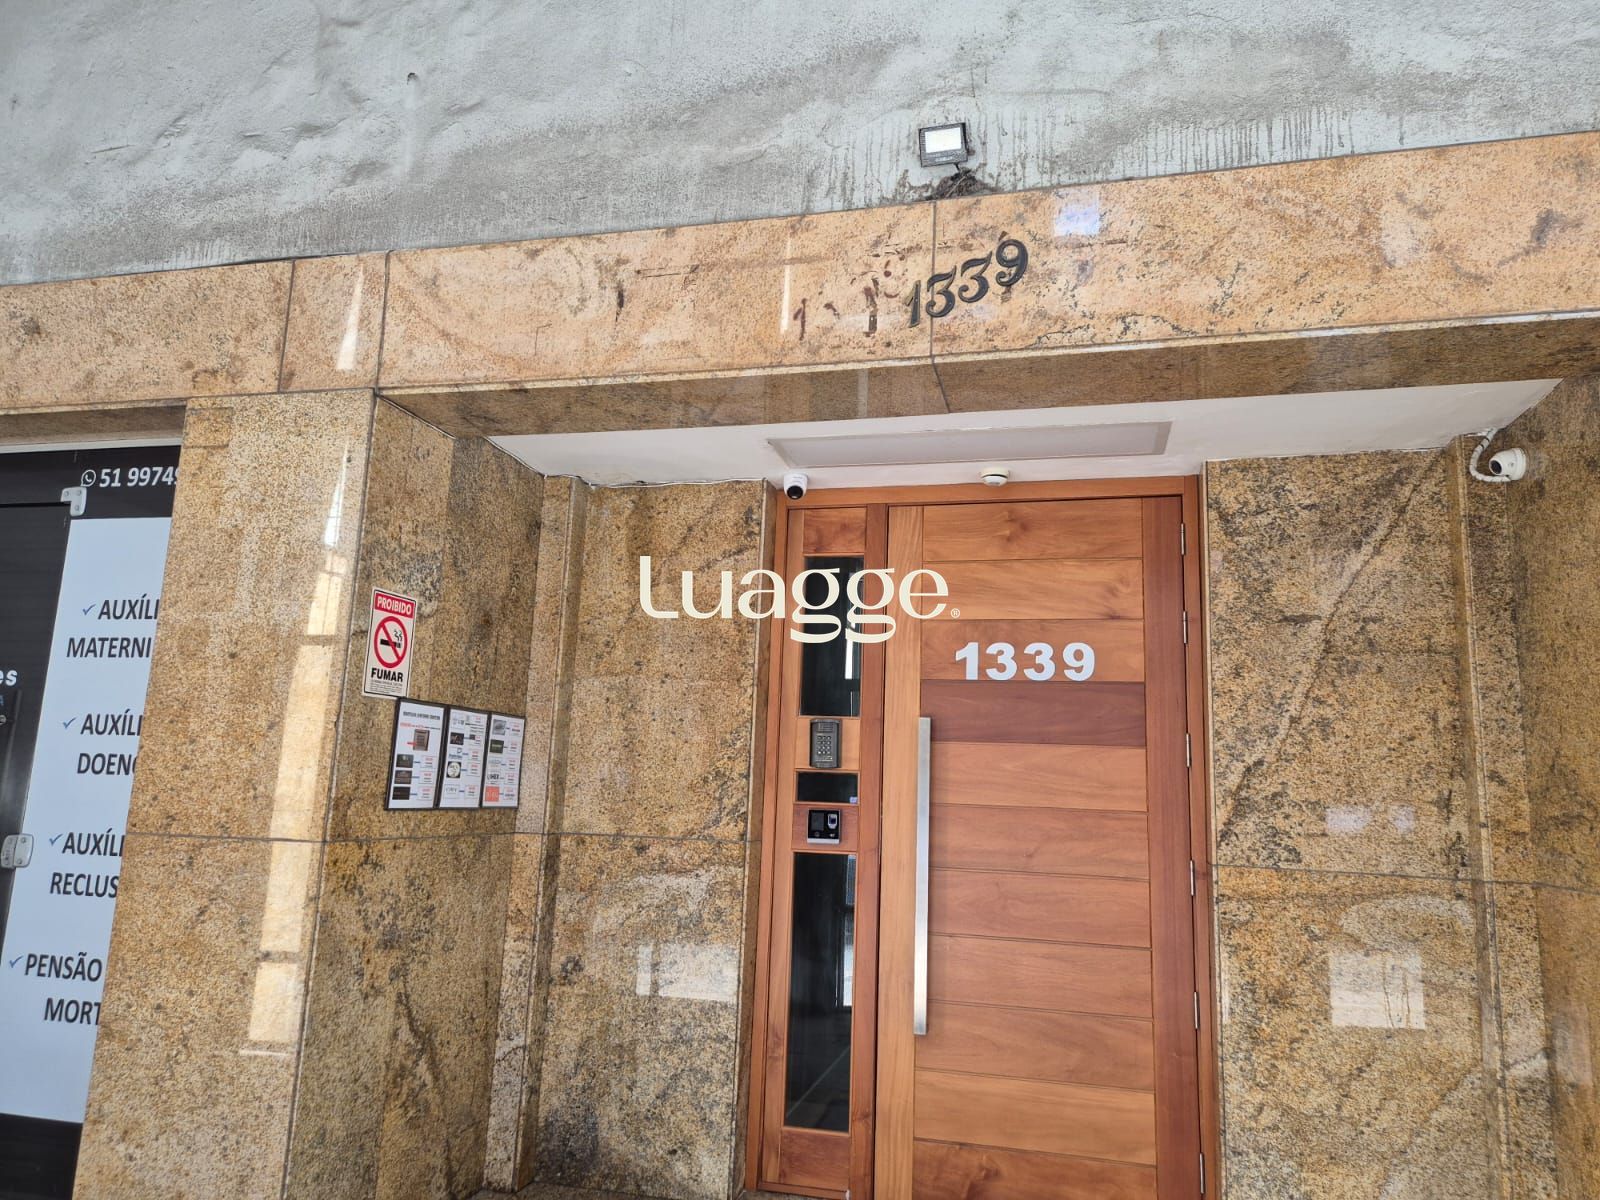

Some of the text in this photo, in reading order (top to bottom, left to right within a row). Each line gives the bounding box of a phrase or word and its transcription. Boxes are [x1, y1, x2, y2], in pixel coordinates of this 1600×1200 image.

[905, 239, 1029, 328] 1339
[99, 468, 121, 488] 51
[377, 596, 412, 615] PROIBIDO
[66, 637, 152, 658] MATERNI
[955, 642, 1096, 681] 1339
[370, 667, 404, 683] FUMAR
[50, 872, 119, 898] RECLUS
[24, 952, 103, 982] PENSÃO
[44, 997, 102, 1025] MORT
